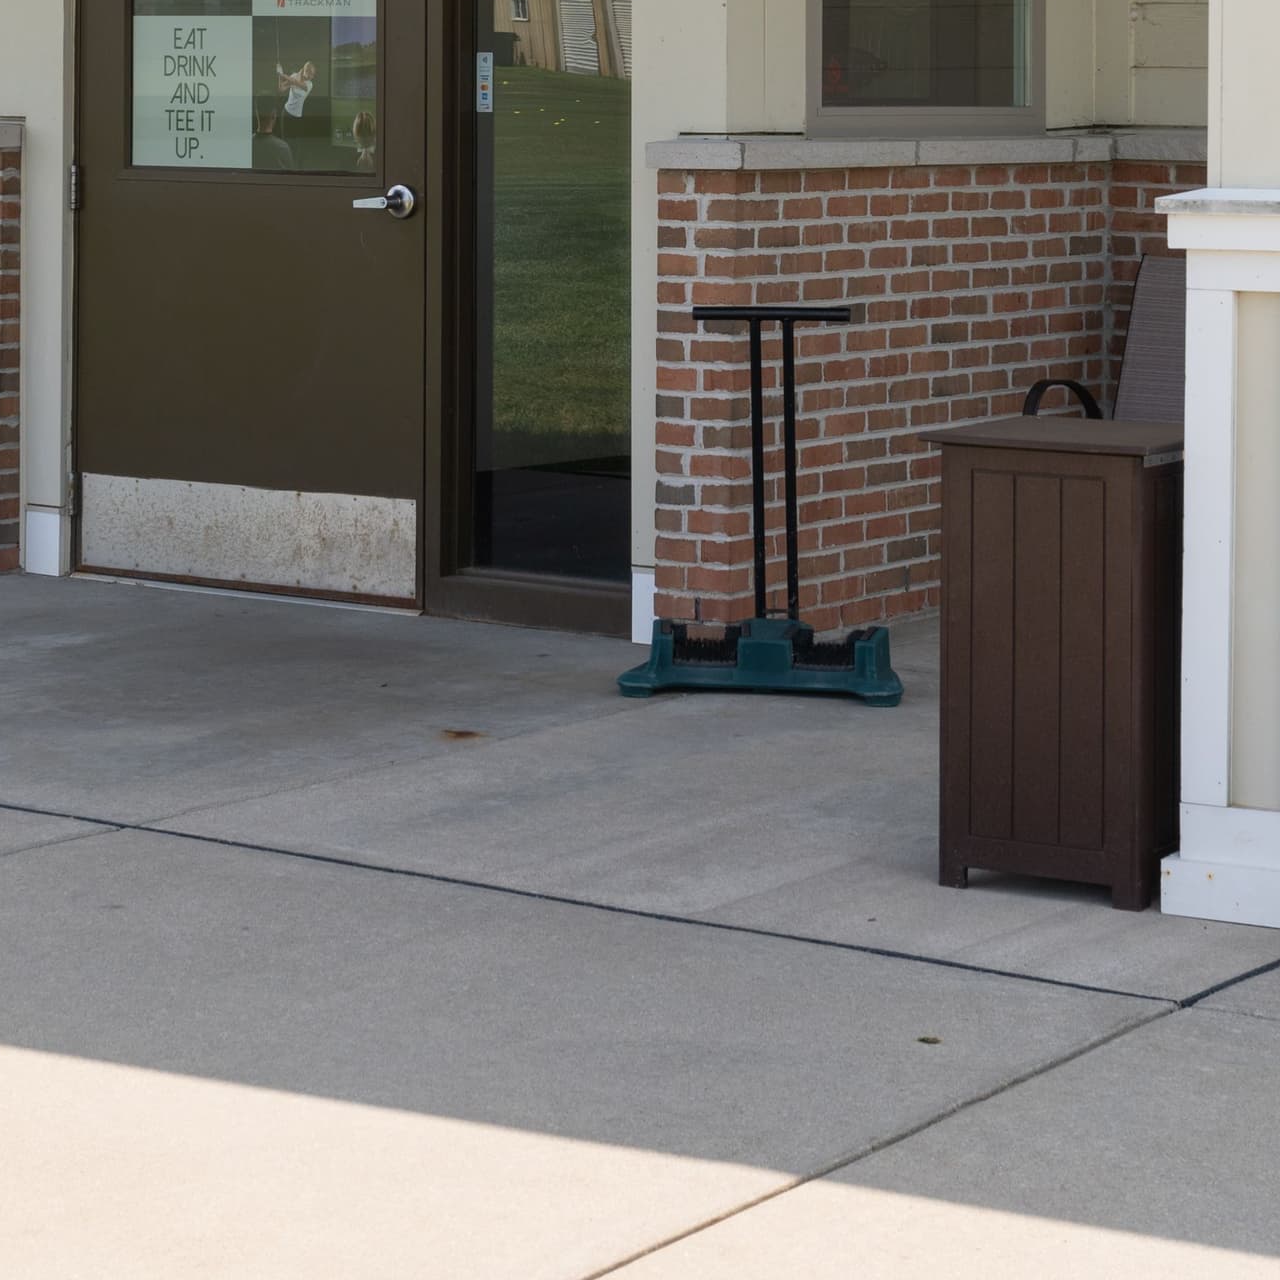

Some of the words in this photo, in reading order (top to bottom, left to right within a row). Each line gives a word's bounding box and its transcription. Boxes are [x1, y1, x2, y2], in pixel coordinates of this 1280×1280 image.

[288, 0, 351, 7] TRACKMAN
[173, 27, 207, 50] EAT
[163, 55, 217, 77] DRINK
[170, 82, 210, 104] AND
[164, 109, 195, 132] TEE
[200, 110, 215, 132] IT
[175, 136, 204, 159] UP.
